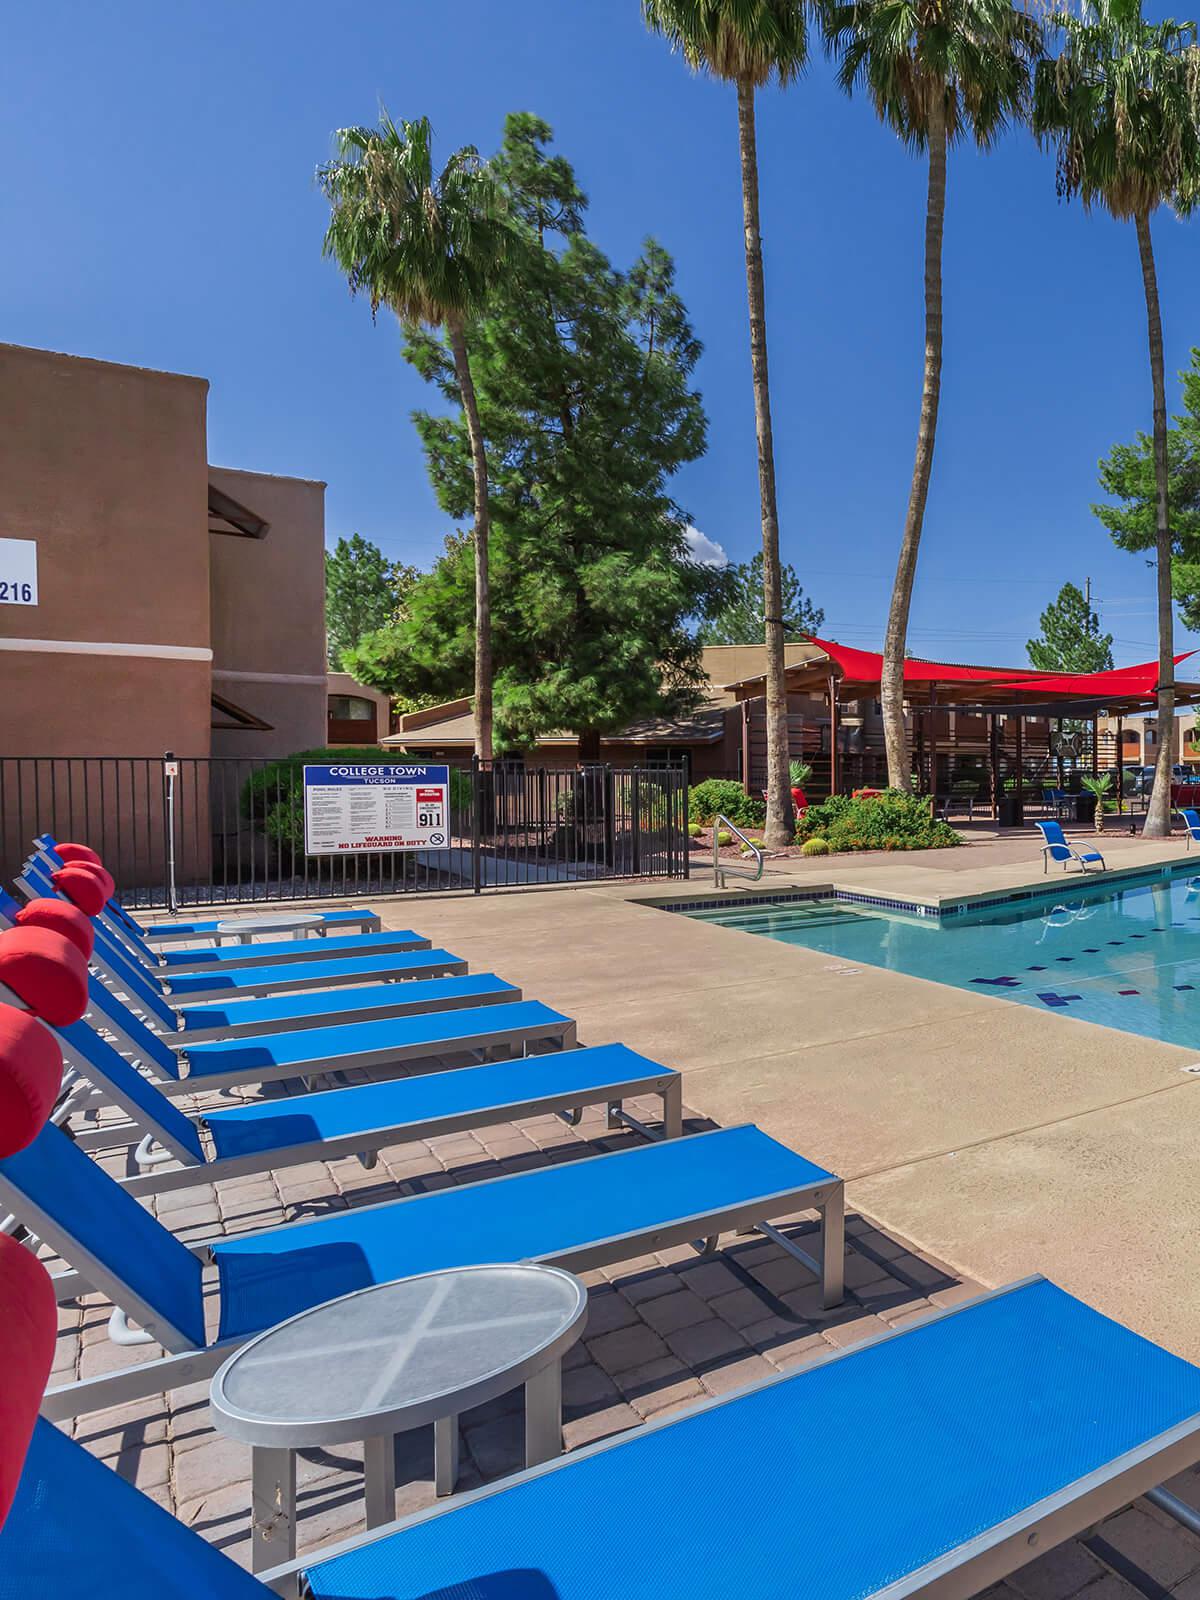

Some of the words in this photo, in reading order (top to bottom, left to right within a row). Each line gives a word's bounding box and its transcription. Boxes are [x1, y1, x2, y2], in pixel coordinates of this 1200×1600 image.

[329, 767, 384, 776] COLLEGE
[389, 767, 427, 775] TOWN
[419, 813, 441, 826] 911
